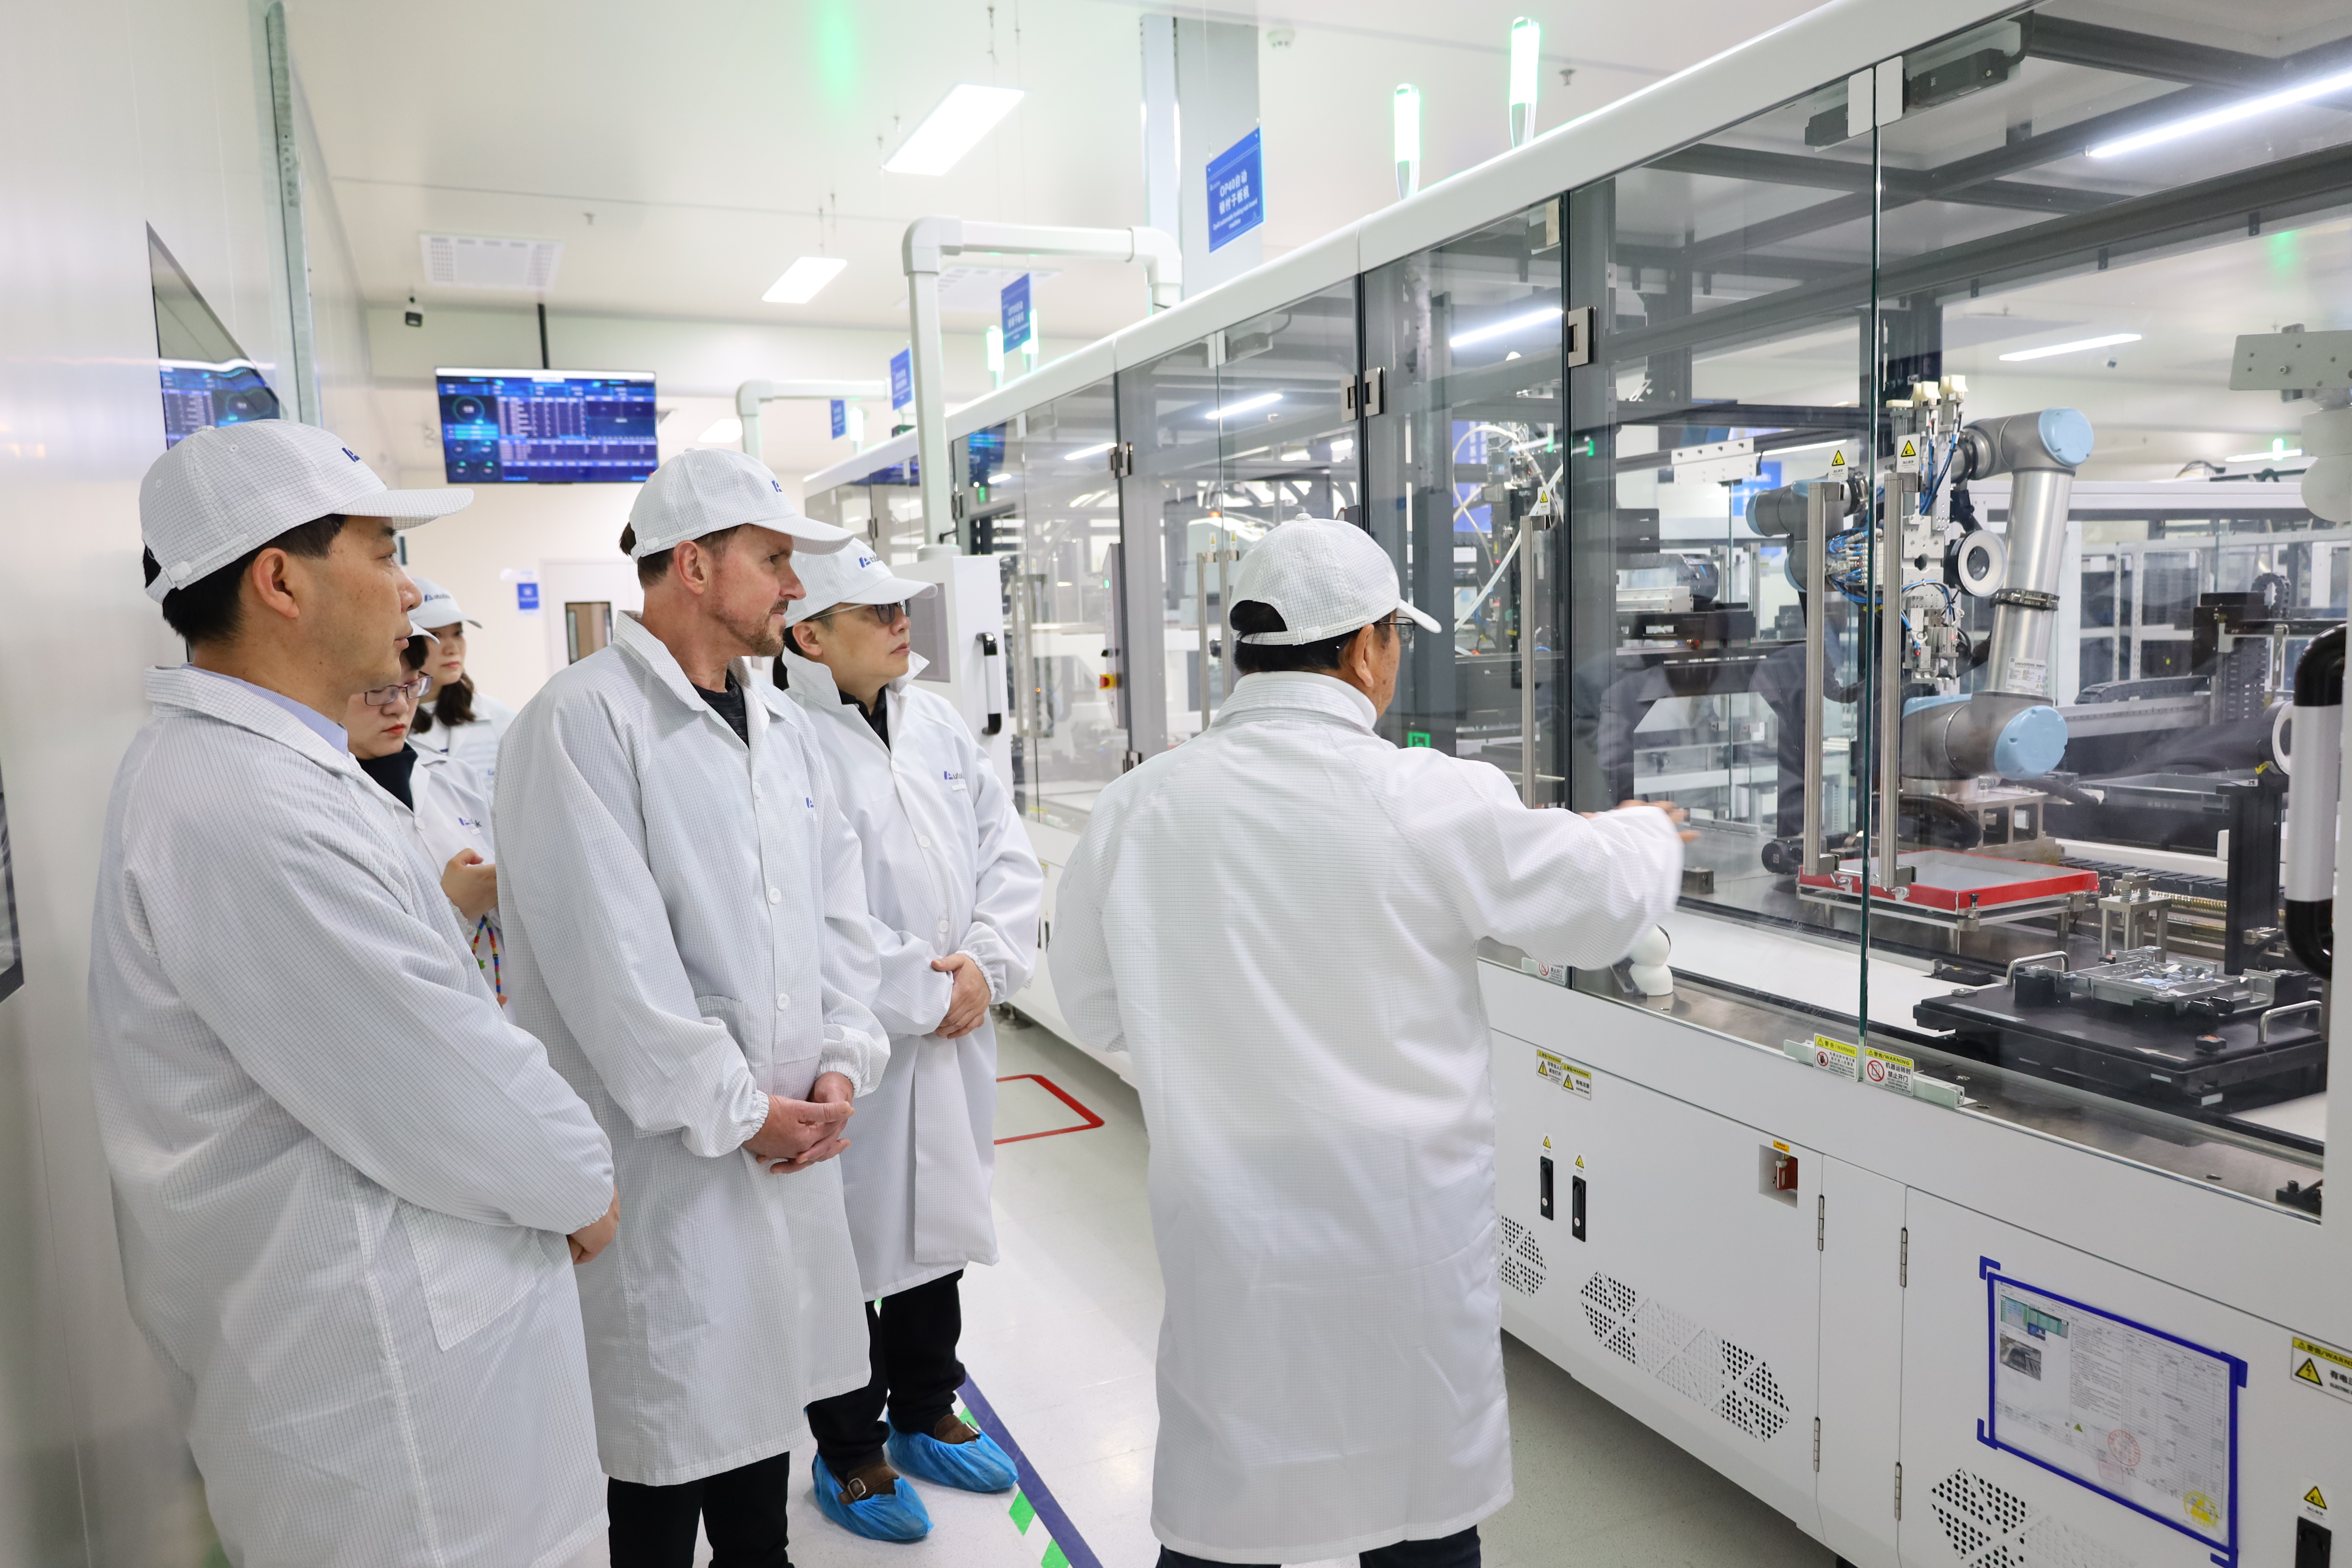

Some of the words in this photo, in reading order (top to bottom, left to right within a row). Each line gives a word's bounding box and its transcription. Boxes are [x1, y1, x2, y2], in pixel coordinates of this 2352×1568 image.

[1885, 1062, 1911, 1075] 机器运转时
[1888, 1071, 1908, 1082] 禁止开门
[1576, 1079, 1589, 1089] 有电注意
